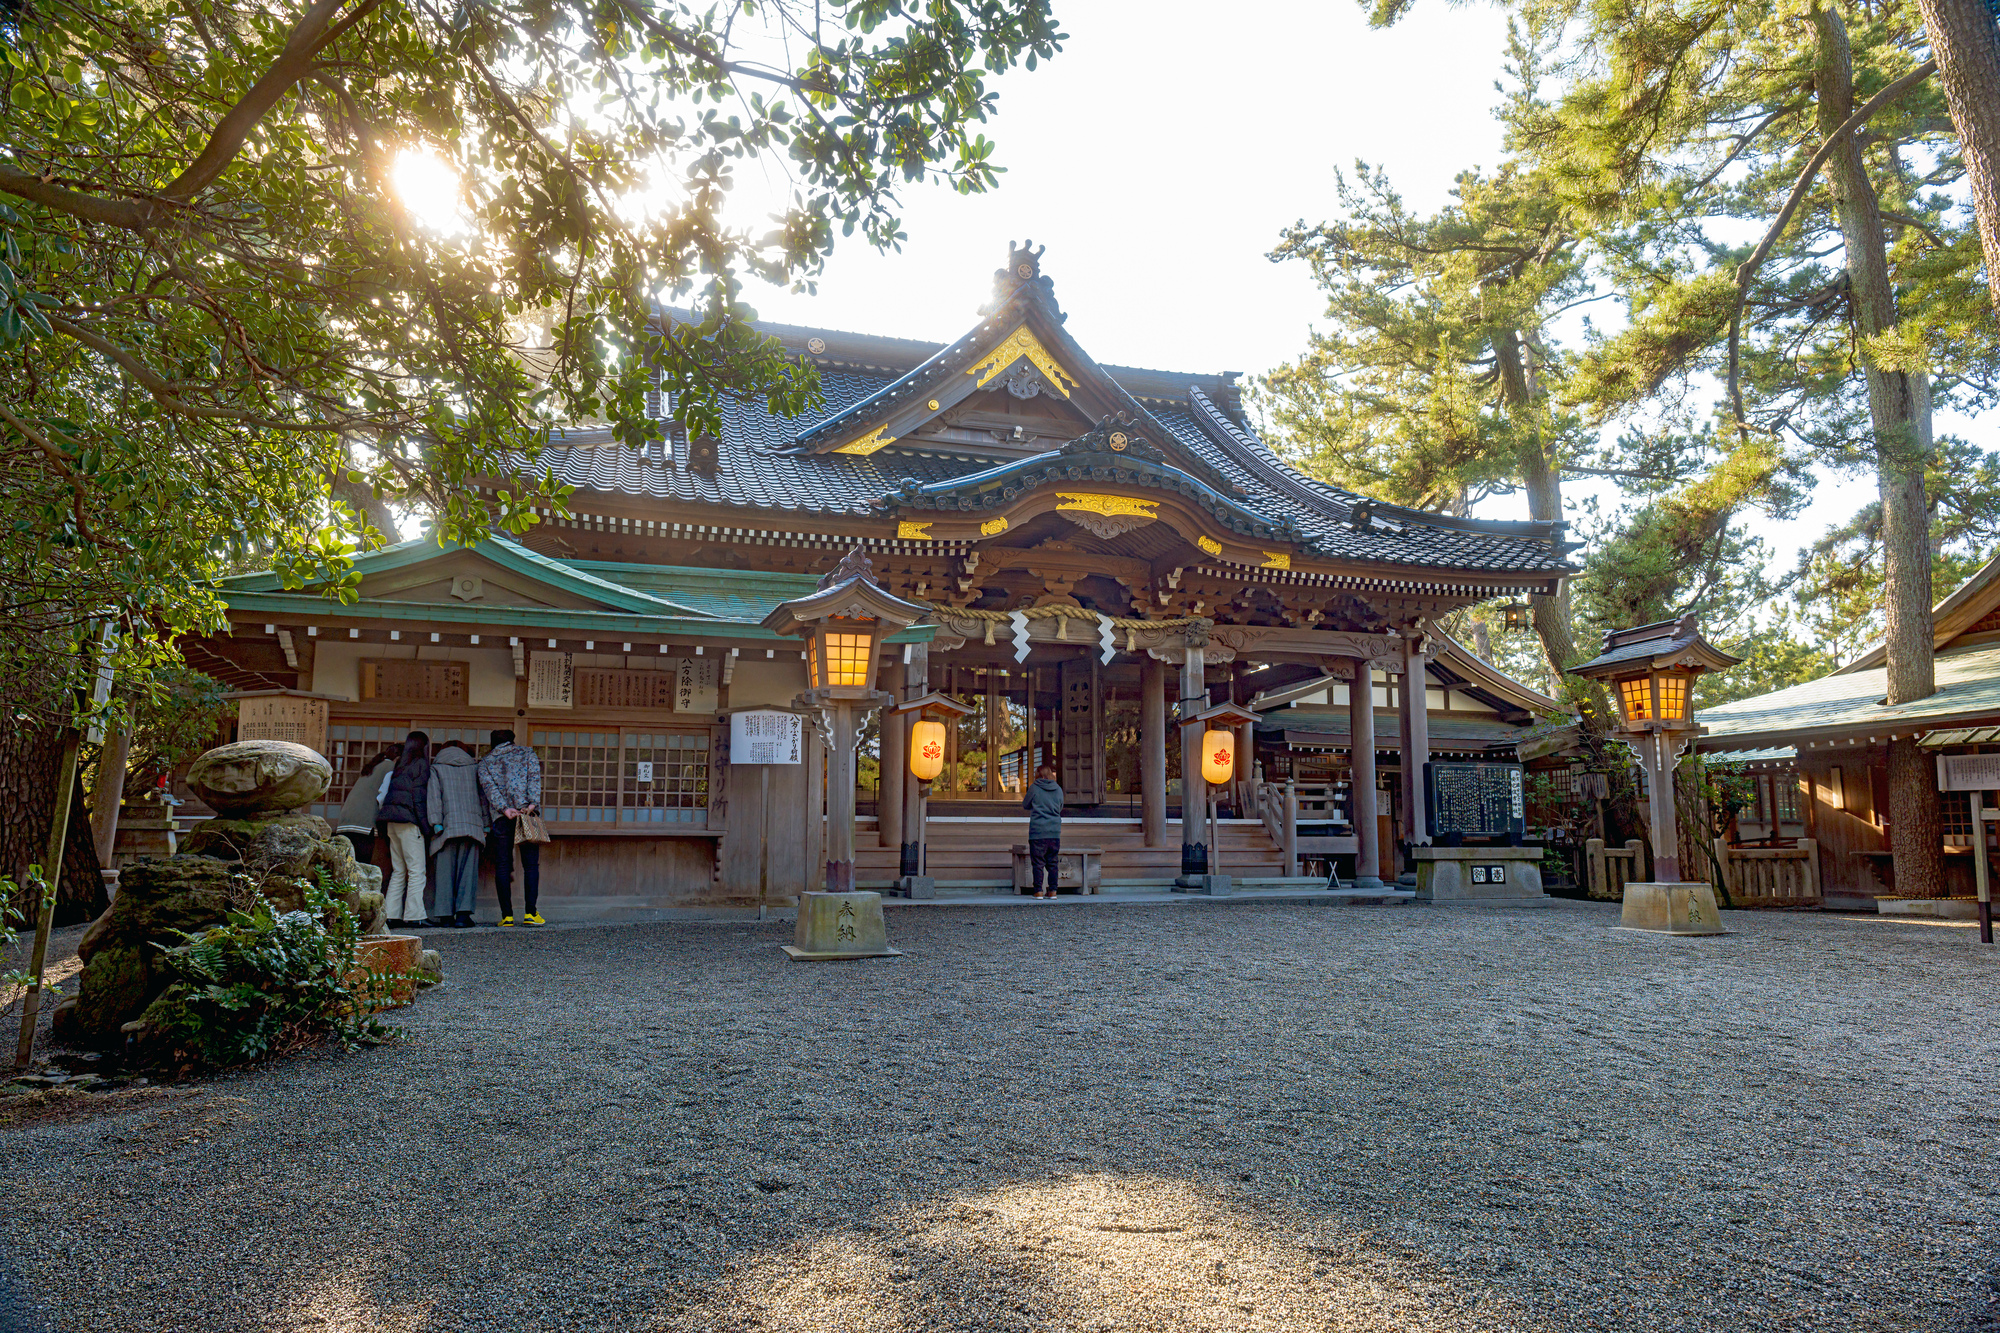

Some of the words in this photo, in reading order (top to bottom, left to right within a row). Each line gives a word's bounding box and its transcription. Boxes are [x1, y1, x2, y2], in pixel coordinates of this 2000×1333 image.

[679, 658, 693, 709] 八方除御守
[711, 735, 729, 819] お守り所
[836, 900, 857, 943] 奉納
